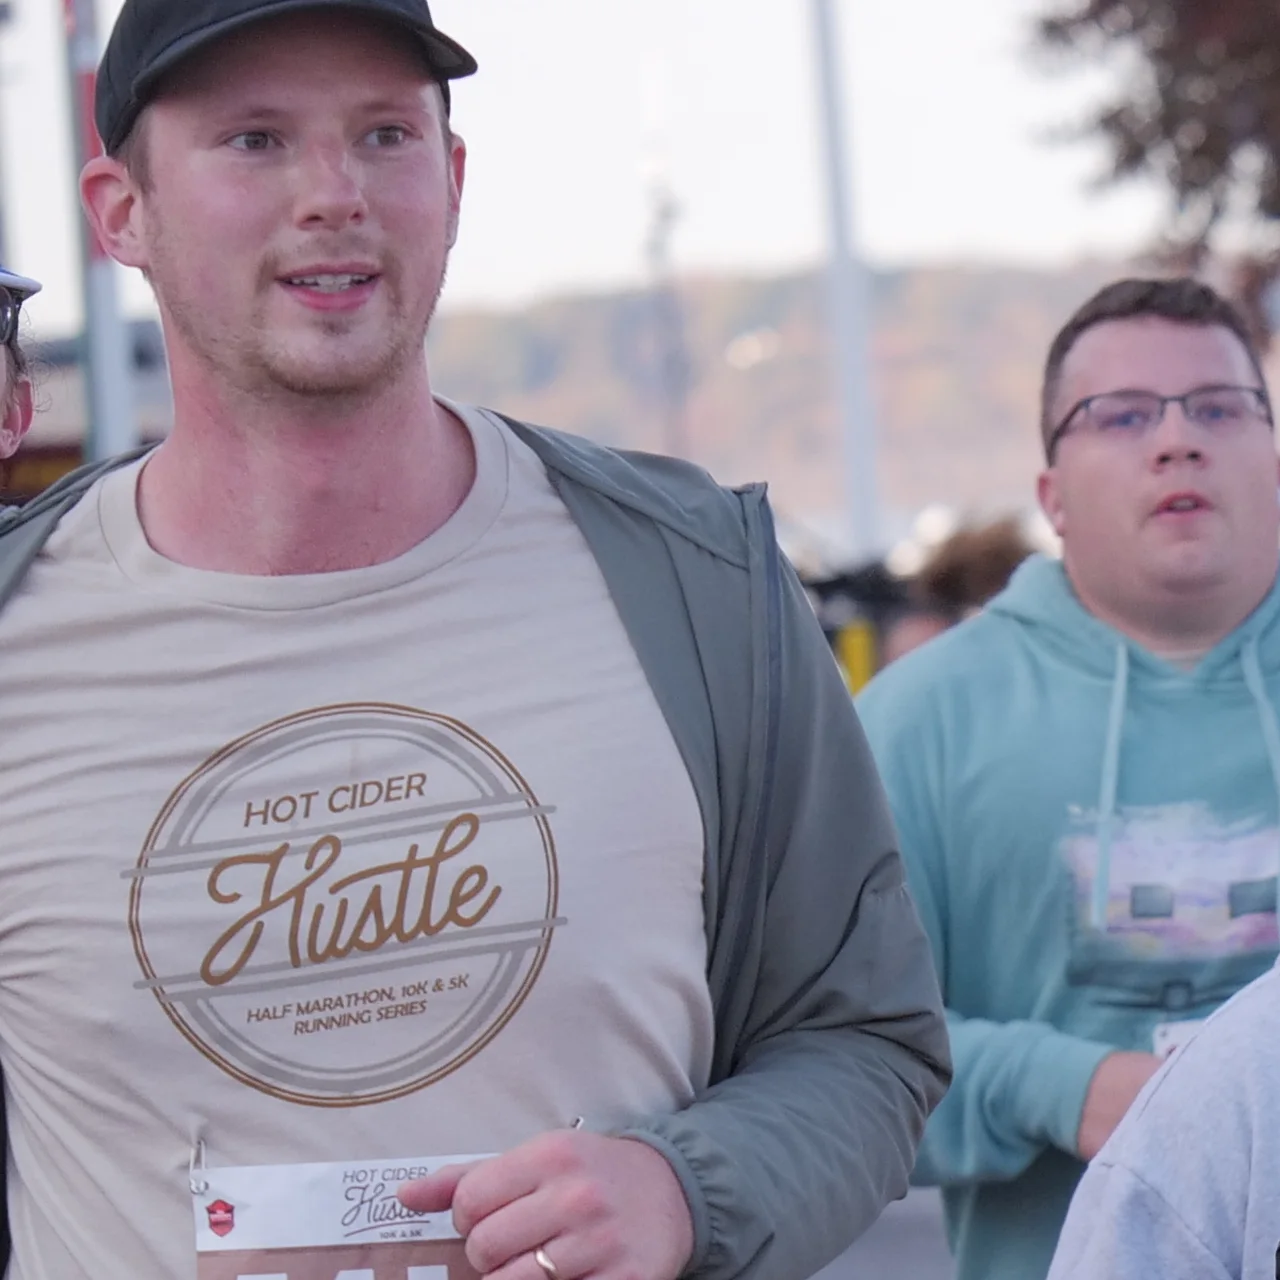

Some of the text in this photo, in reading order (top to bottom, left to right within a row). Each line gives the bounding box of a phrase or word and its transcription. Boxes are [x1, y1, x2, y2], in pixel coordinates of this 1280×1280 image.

[243, 772, 427, 827] HOT CIDER
[199, 812, 502, 986] Hustle
[246, 973, 469, 1023] HALF MARATHON, 10K & 5K
[293, 1000, 428, 1036] RUNNING SERIES
[342, 1166, 429, 1184] HOT CIDER
